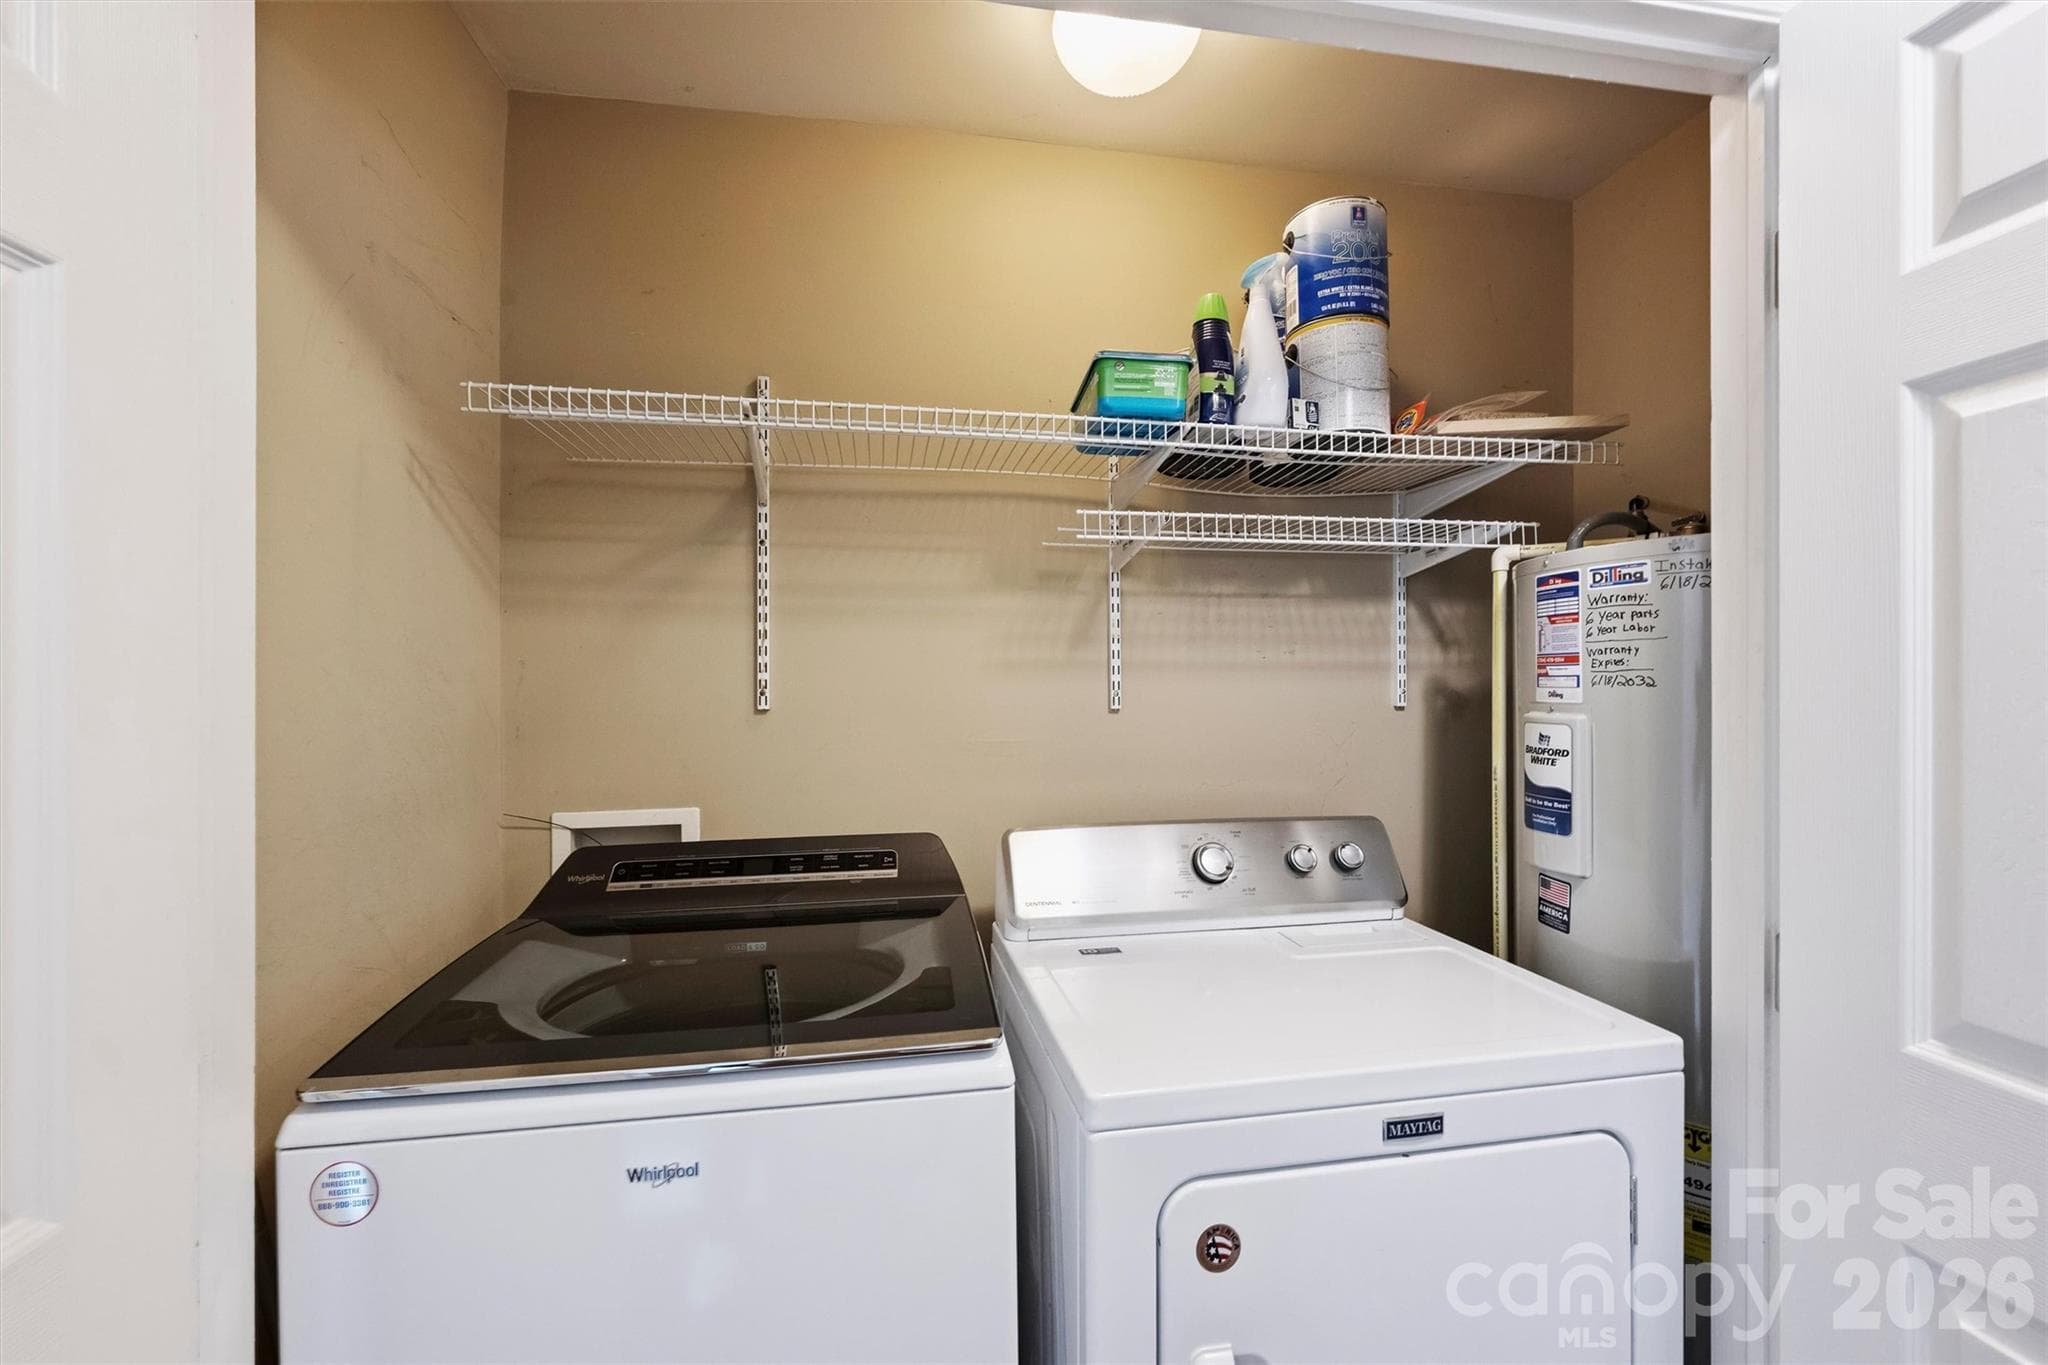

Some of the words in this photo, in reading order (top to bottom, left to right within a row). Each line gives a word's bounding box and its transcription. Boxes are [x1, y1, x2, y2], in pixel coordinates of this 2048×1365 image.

[1587, 593, 1649, 606] Warranty:
[1585, 612, 1594, 625] 6
[1585, 627, 1593, 638] 6
[1623, 623, 1656, 633] Labor
[1586, 646, 1640, 657] Warranty
[1591, 658, 1630, 669] Expires:
[1591, 675, 1658, 688] 6/18/2032
[1525, 745, 1570, 758] BRADFORD
[1530, 754, 1557, 766] WHITE
[1389, 1120, 1441, 1137] MAYTAG
[328, 1170, 360, 1179] REGISTER
[627, 1162, 699, 1186] Whirlpool
[1206, 1227, 1240, 1251] AMERICA
